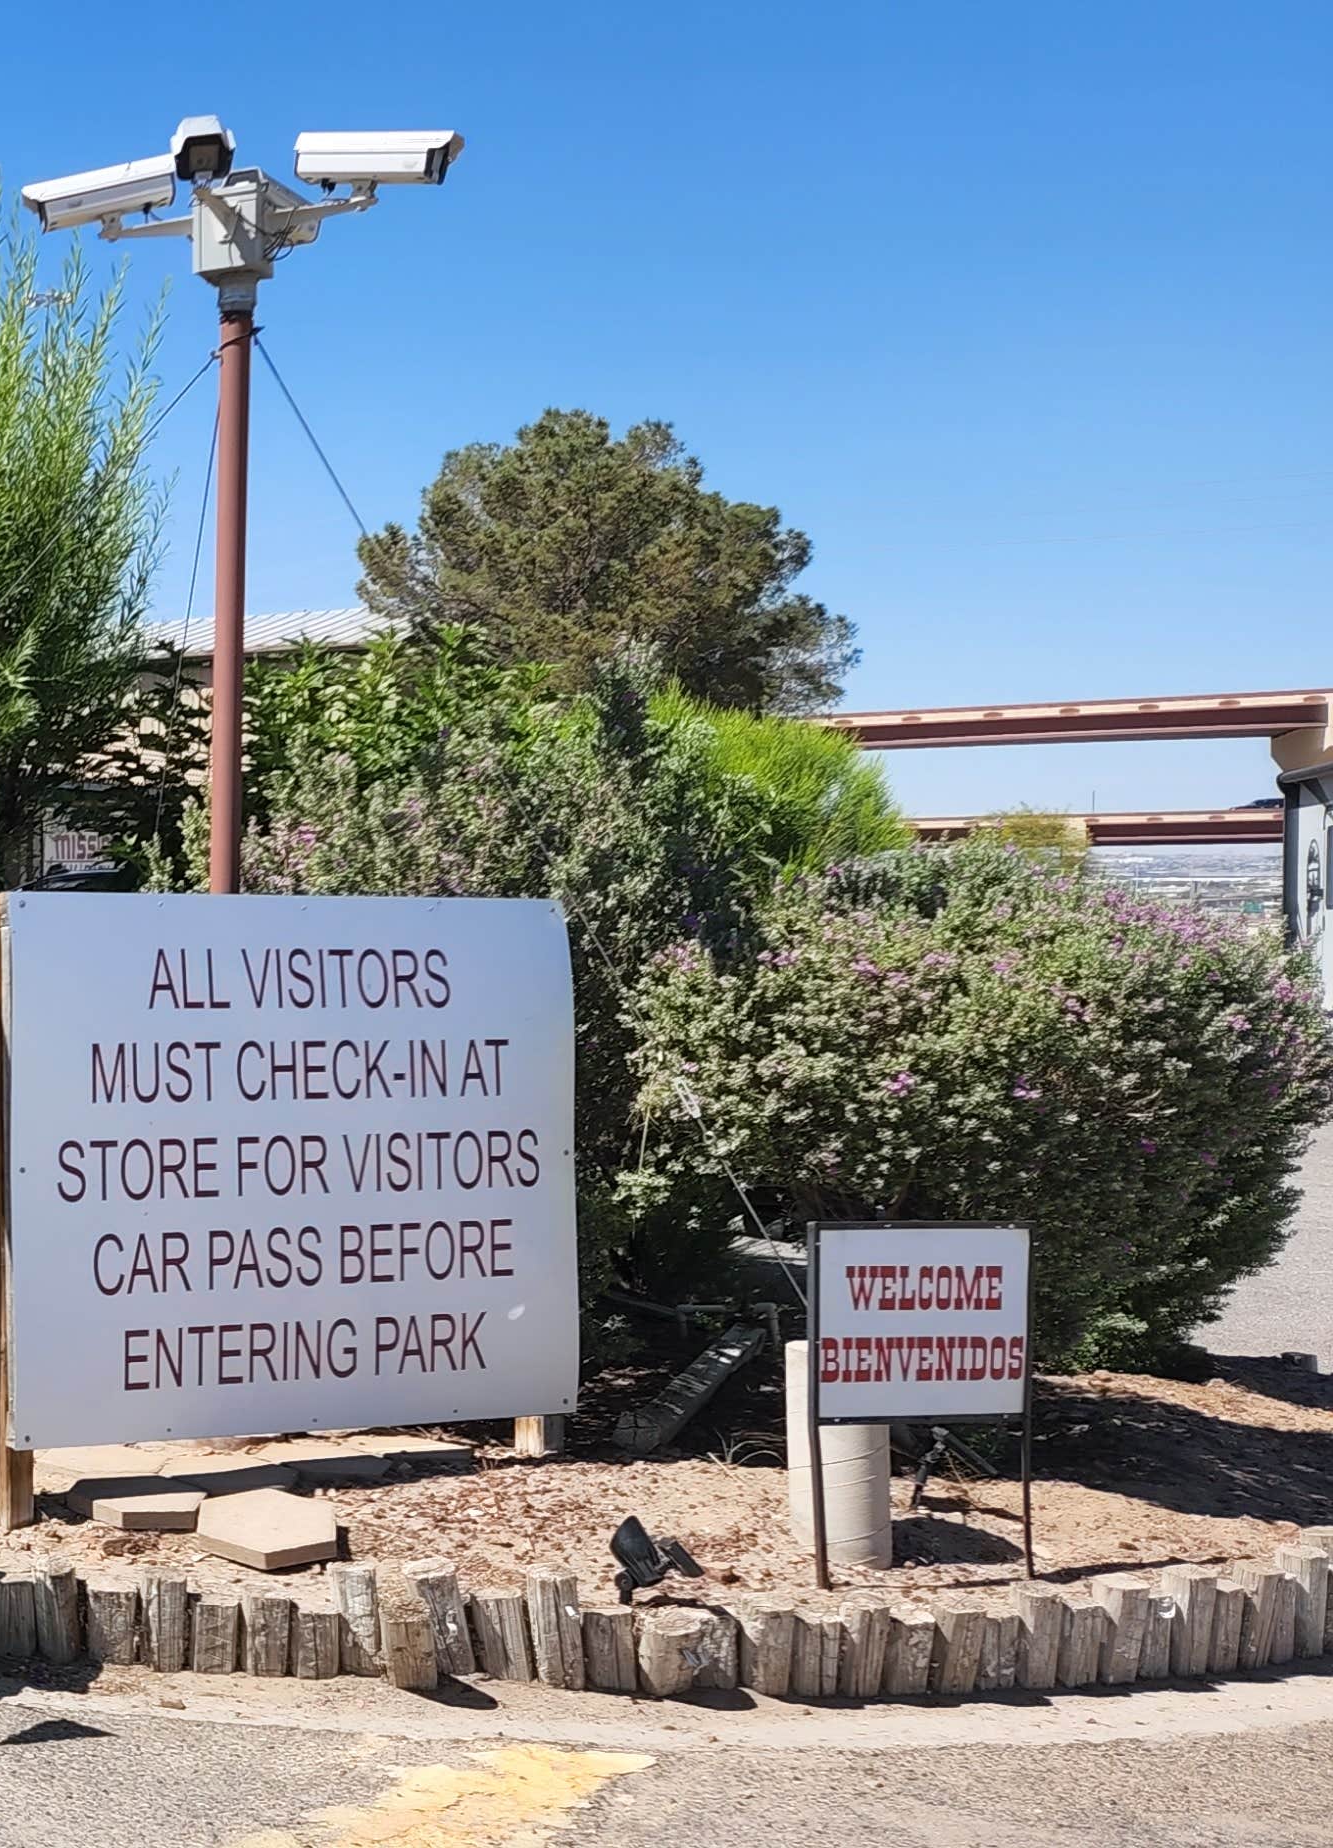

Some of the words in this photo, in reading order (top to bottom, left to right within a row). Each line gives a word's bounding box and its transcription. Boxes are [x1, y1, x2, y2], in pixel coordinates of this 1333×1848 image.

[148, 948, 231, 1010] ALL
[241, 948, 451, 1010] VISITORS
[91, 1041, 221, 1104] MUST
[236, 1039, 447, 1101] CHECK-IN
[459, 1038, 509, 1098] AT
[56, 1137, 220, 1203] STORE
[237, 1135, 330, 1198] FOR
[342, 1128, 541, 1194] VISITORS
[93, 1231, 191, 1297] CAR
[208, 1226, 323, 1291] PASS
[339, 1218, 514, 1285] BEFORE
[845, 1265, 1002, 1311] WELCOME
[124, 1317, 358, 1391] ENTERING
[374, 1311, 487, 1376] PARK
[821, 1335, 1023, 1383] BIENVENIDOS
